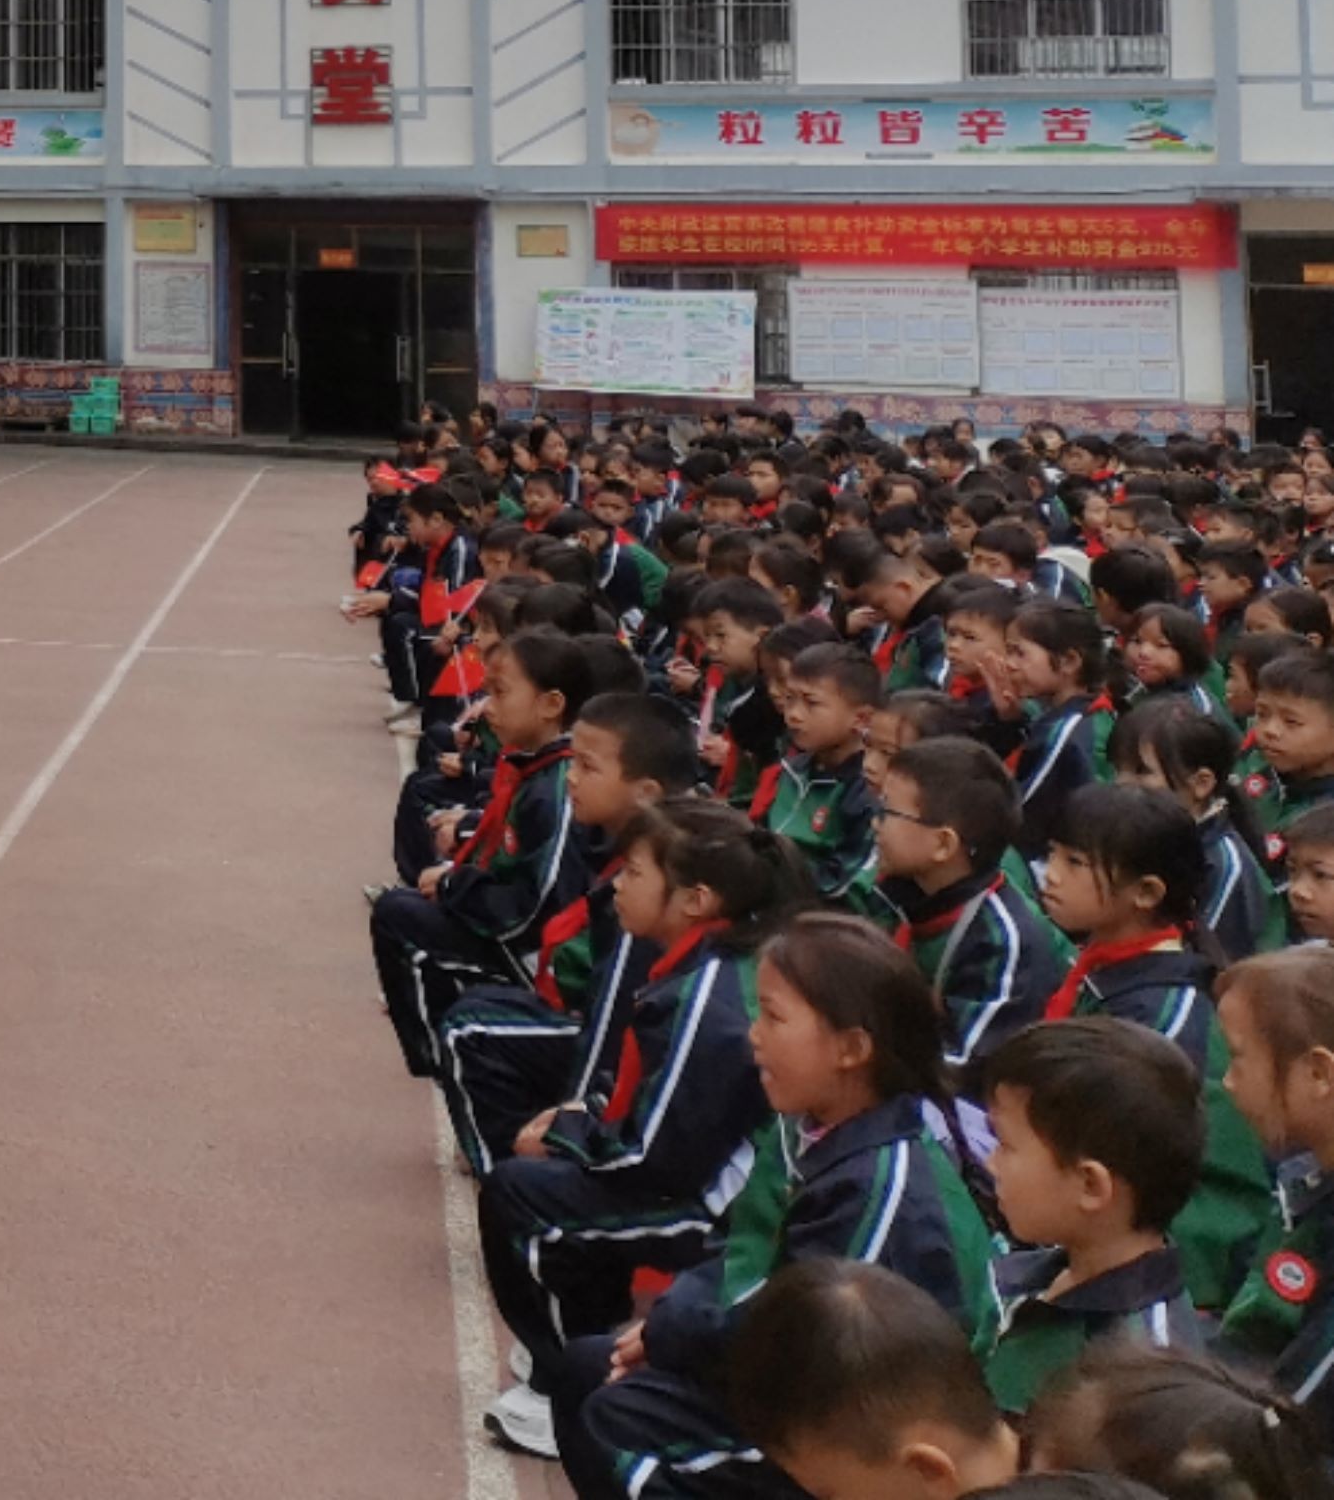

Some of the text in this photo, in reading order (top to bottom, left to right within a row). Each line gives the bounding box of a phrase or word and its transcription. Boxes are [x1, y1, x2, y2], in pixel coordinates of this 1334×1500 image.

[718, 107, 1093, 146] 粒粒皆辛苦
